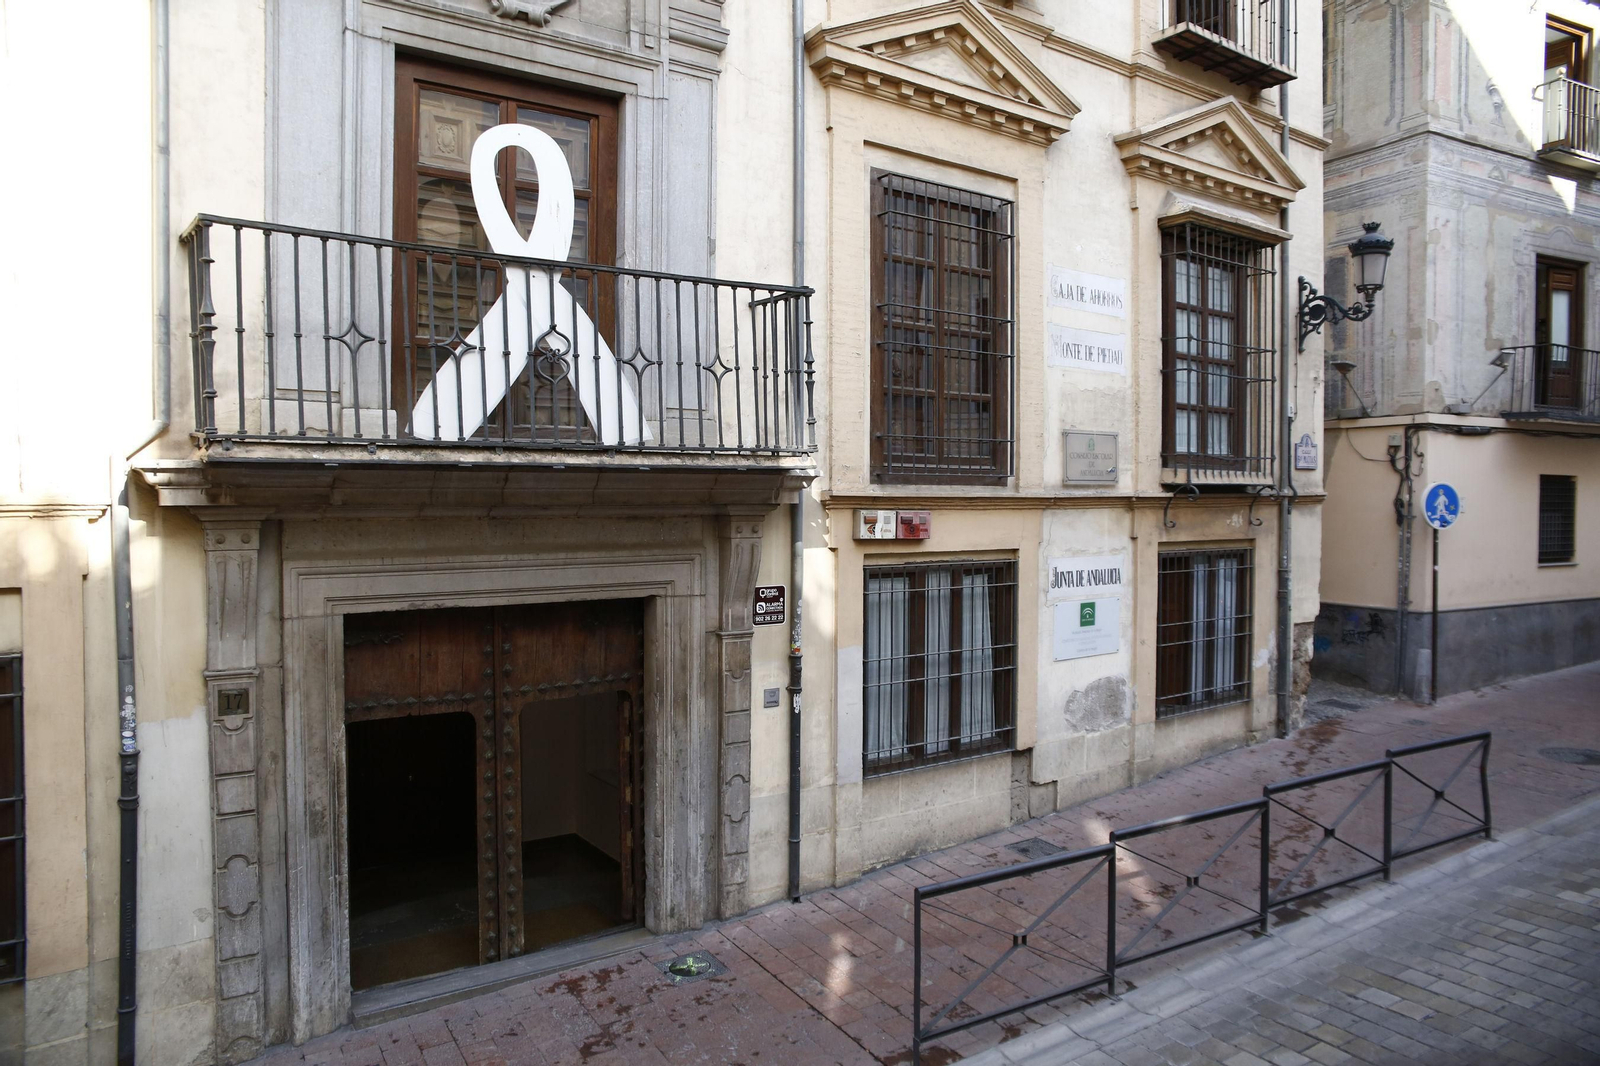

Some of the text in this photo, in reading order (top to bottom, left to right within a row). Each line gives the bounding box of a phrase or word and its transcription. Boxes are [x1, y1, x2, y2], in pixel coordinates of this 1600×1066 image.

[1050, 274, 1123, 310] CAJA DE AHORROS
[1084, 344, 1096, 362] DE
[1097, 346, 1123, 366] PIEDAD
[1050, 566, 1075, 589] JUNTA
[1076, 570, 1085, 588] DE
[223, 693, 243, 710] 17
